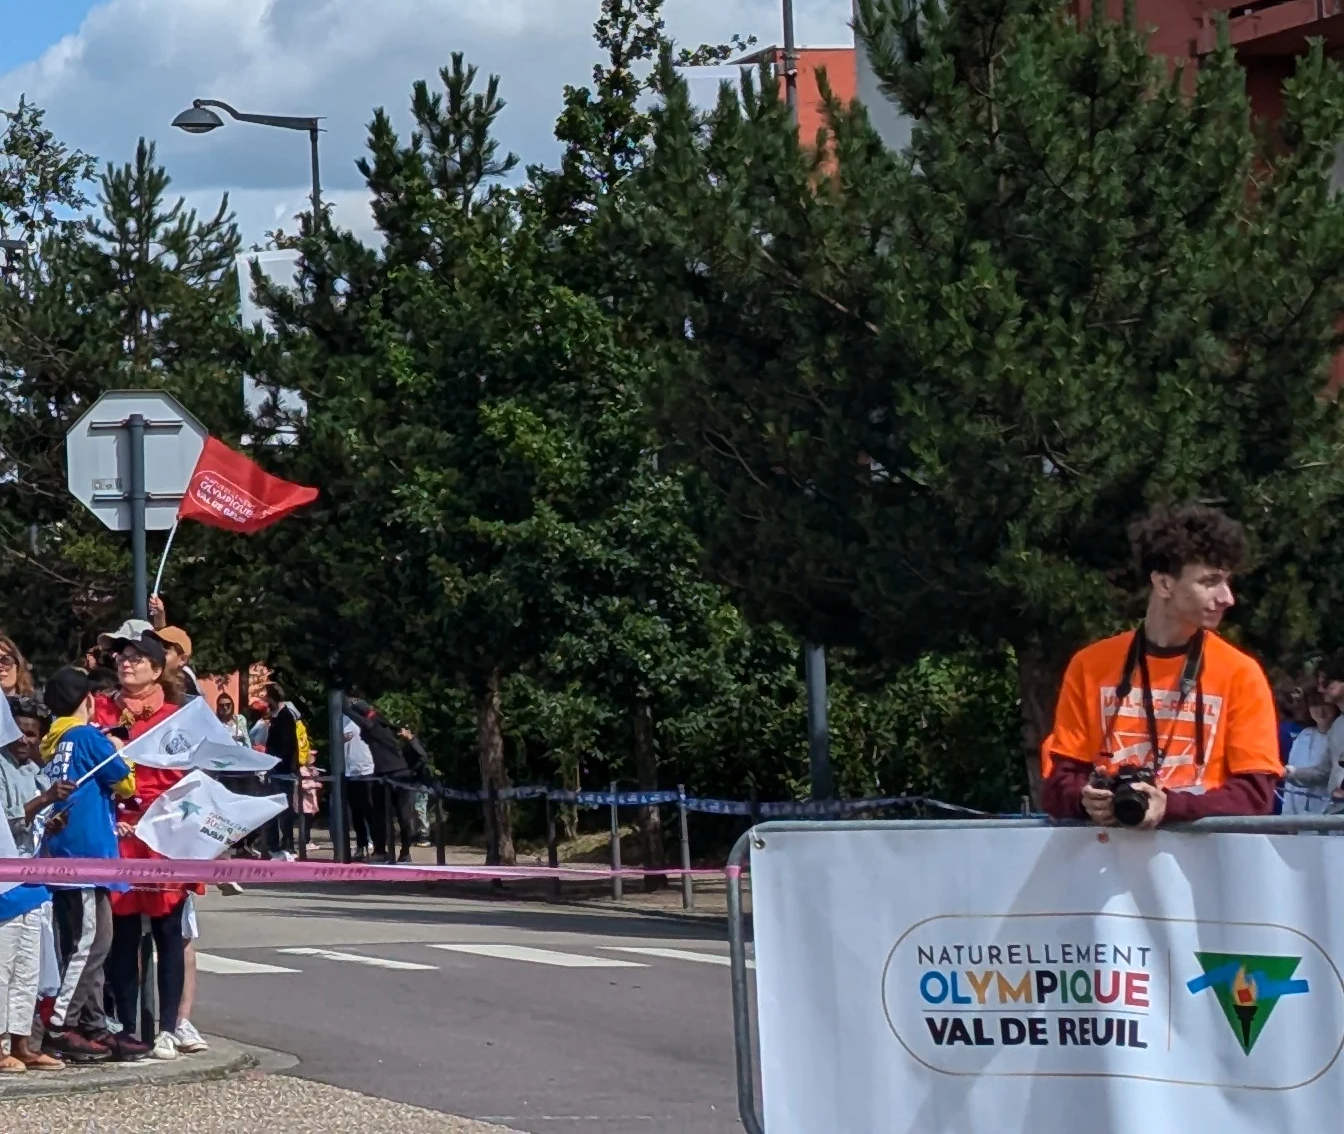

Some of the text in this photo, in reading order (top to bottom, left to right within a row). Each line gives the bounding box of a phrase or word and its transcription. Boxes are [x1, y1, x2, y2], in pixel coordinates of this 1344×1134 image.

[917, 943, 1151, 967] NATURELLEMENT
[920, 969, 1150, 1008] OLYMPIQUE
[925, 1017, 1148, 1049] VAL DE REUIL
